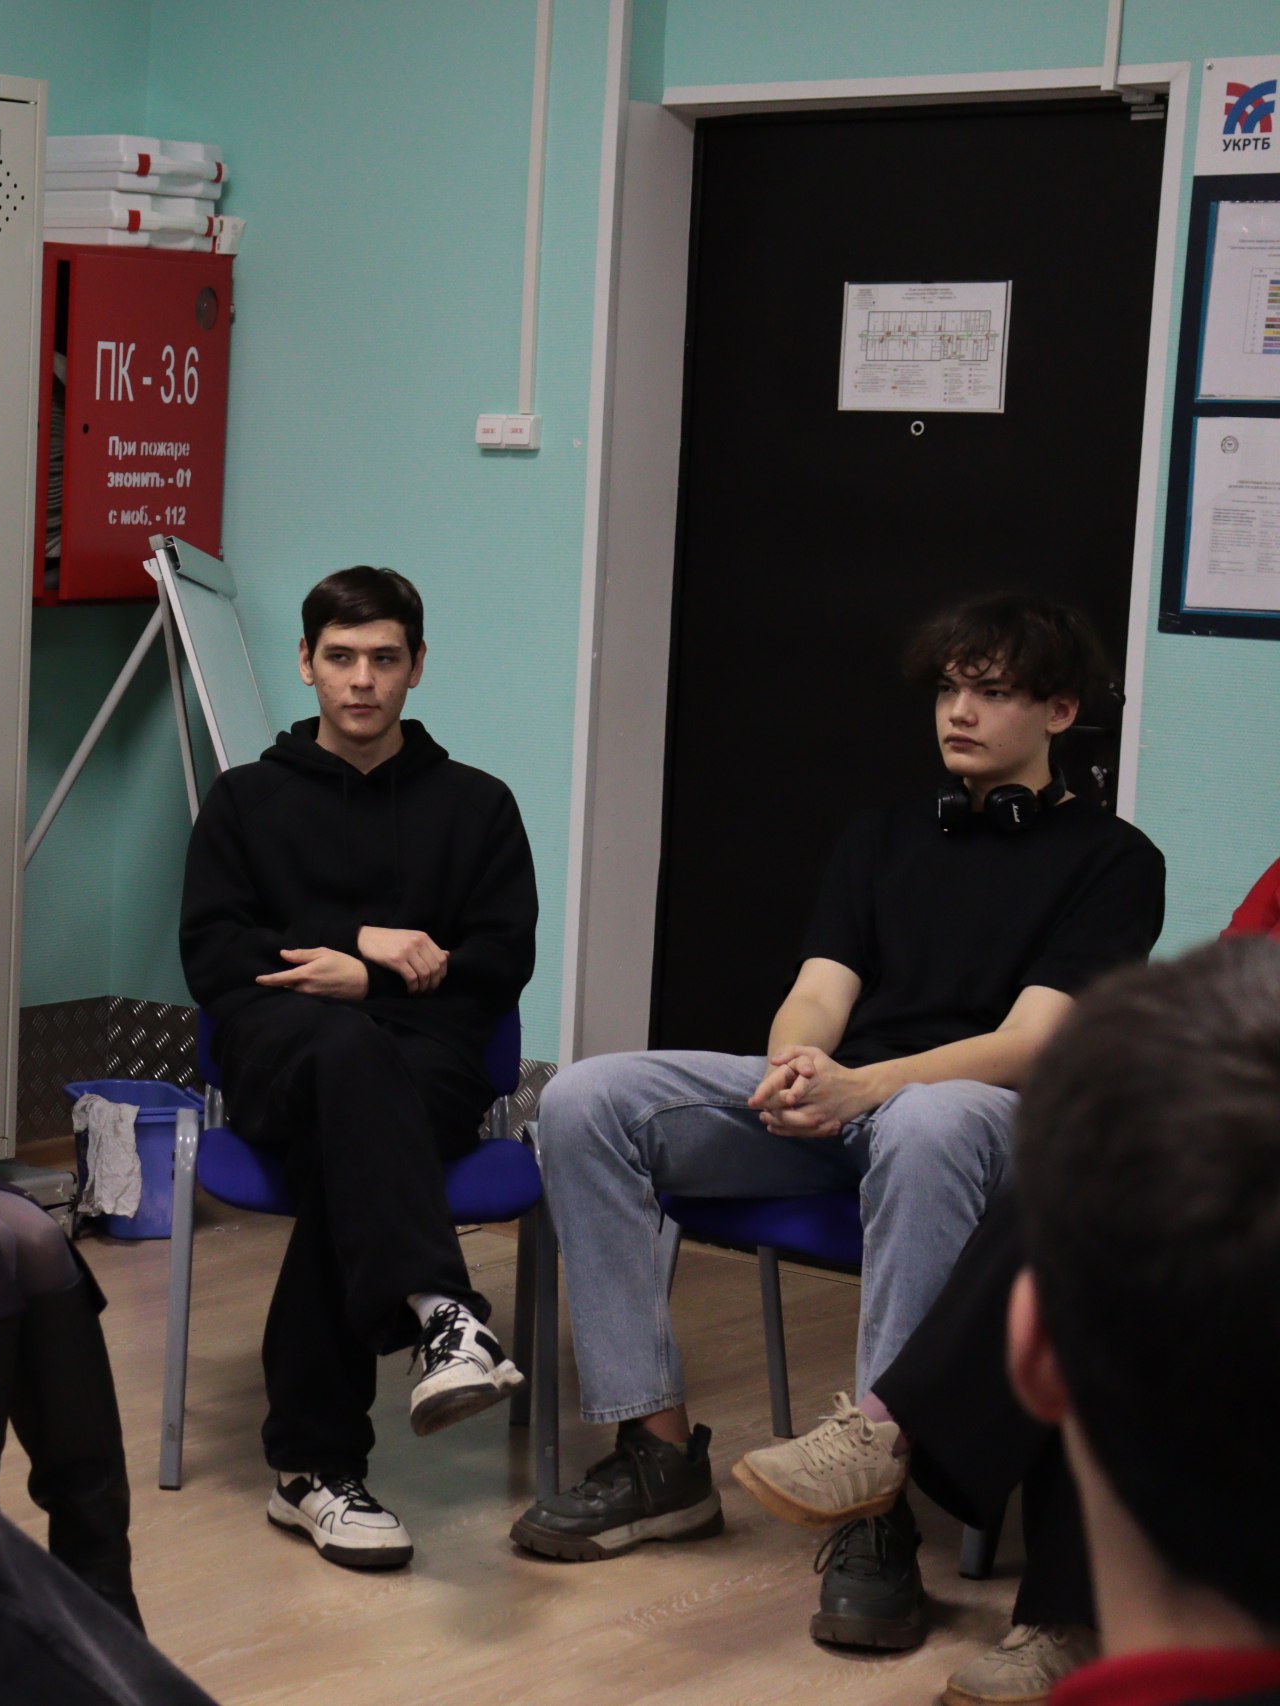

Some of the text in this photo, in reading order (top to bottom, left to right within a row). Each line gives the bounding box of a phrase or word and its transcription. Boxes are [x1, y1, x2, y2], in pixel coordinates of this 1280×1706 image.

[1222, 137, 1271, 152] УКРТБ
[95, 340, 199, 405] ПК - 3.6
[108, 435, 190, 461] При пожаре
[107, 471, 165, 488] звонить
[176, 468, 192, 488] 01
[108, 508, 117, 525] с
[120, 505, 152, 526] моб.
[164, 506, 186, 526] 112
